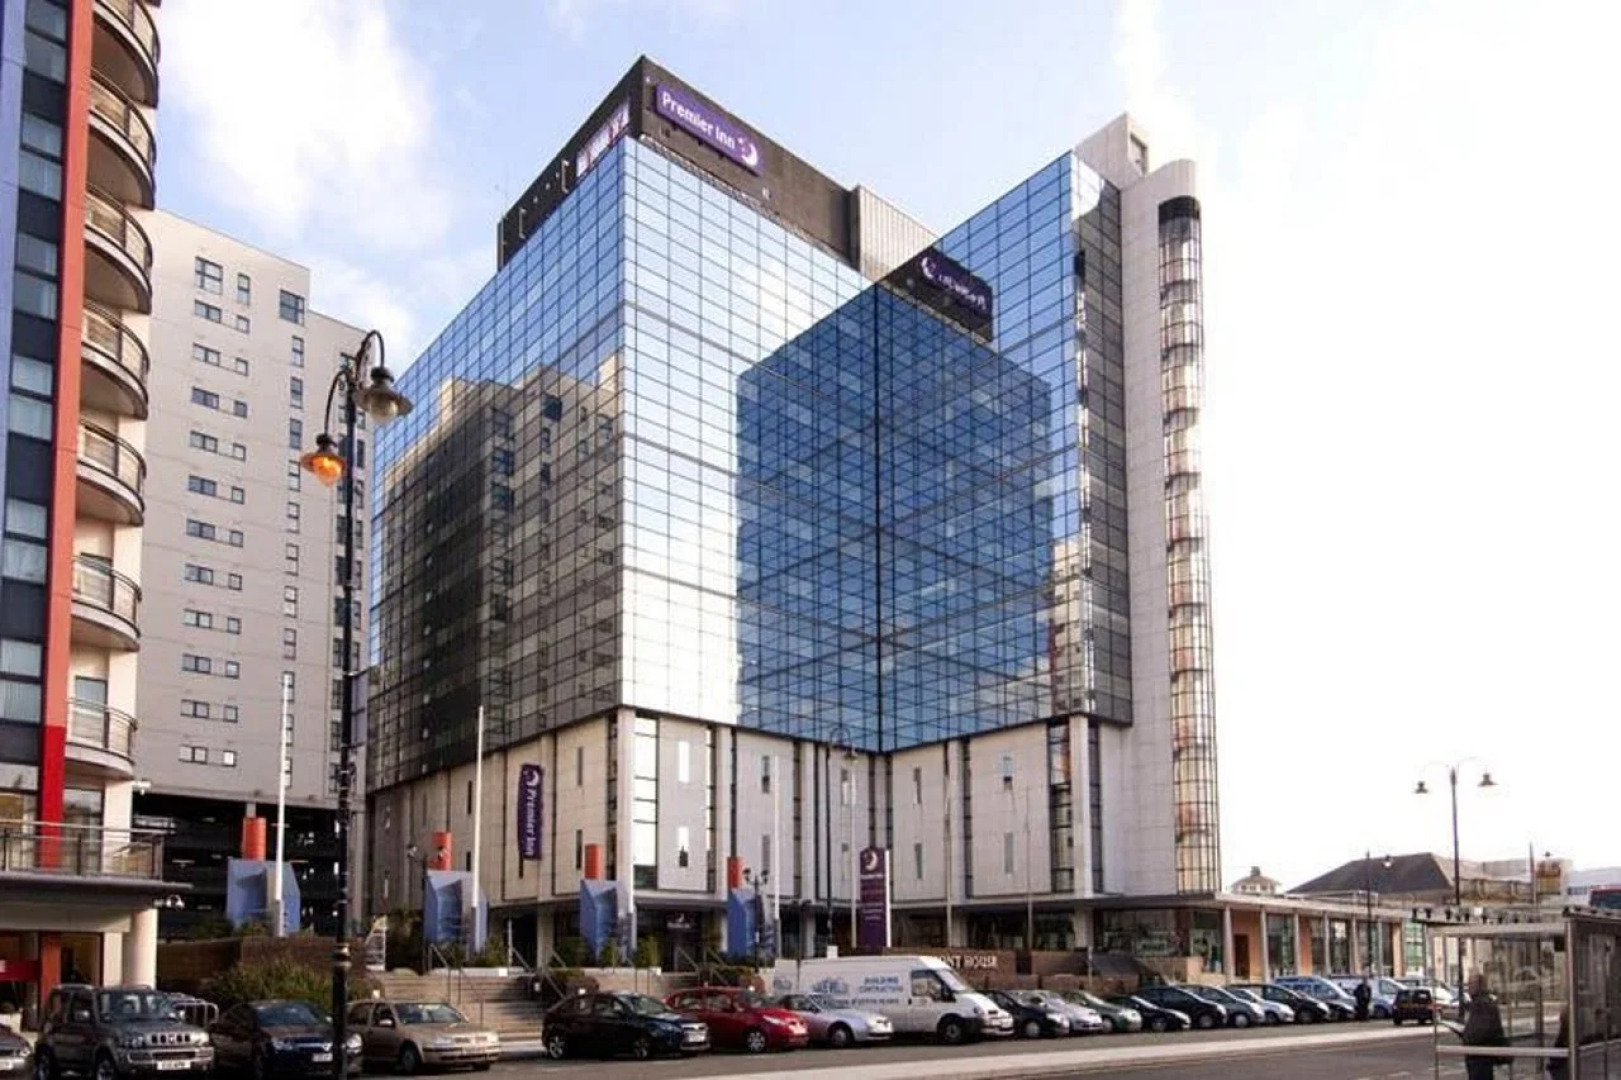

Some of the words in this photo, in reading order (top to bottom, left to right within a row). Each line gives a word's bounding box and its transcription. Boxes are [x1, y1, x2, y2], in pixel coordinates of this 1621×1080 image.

[662, 90, 714, 137] Premier
[715, 126, 736, 149] Inn
[526, 789, 537, 834] Premier
[525, 837, 537, 856] Inn
